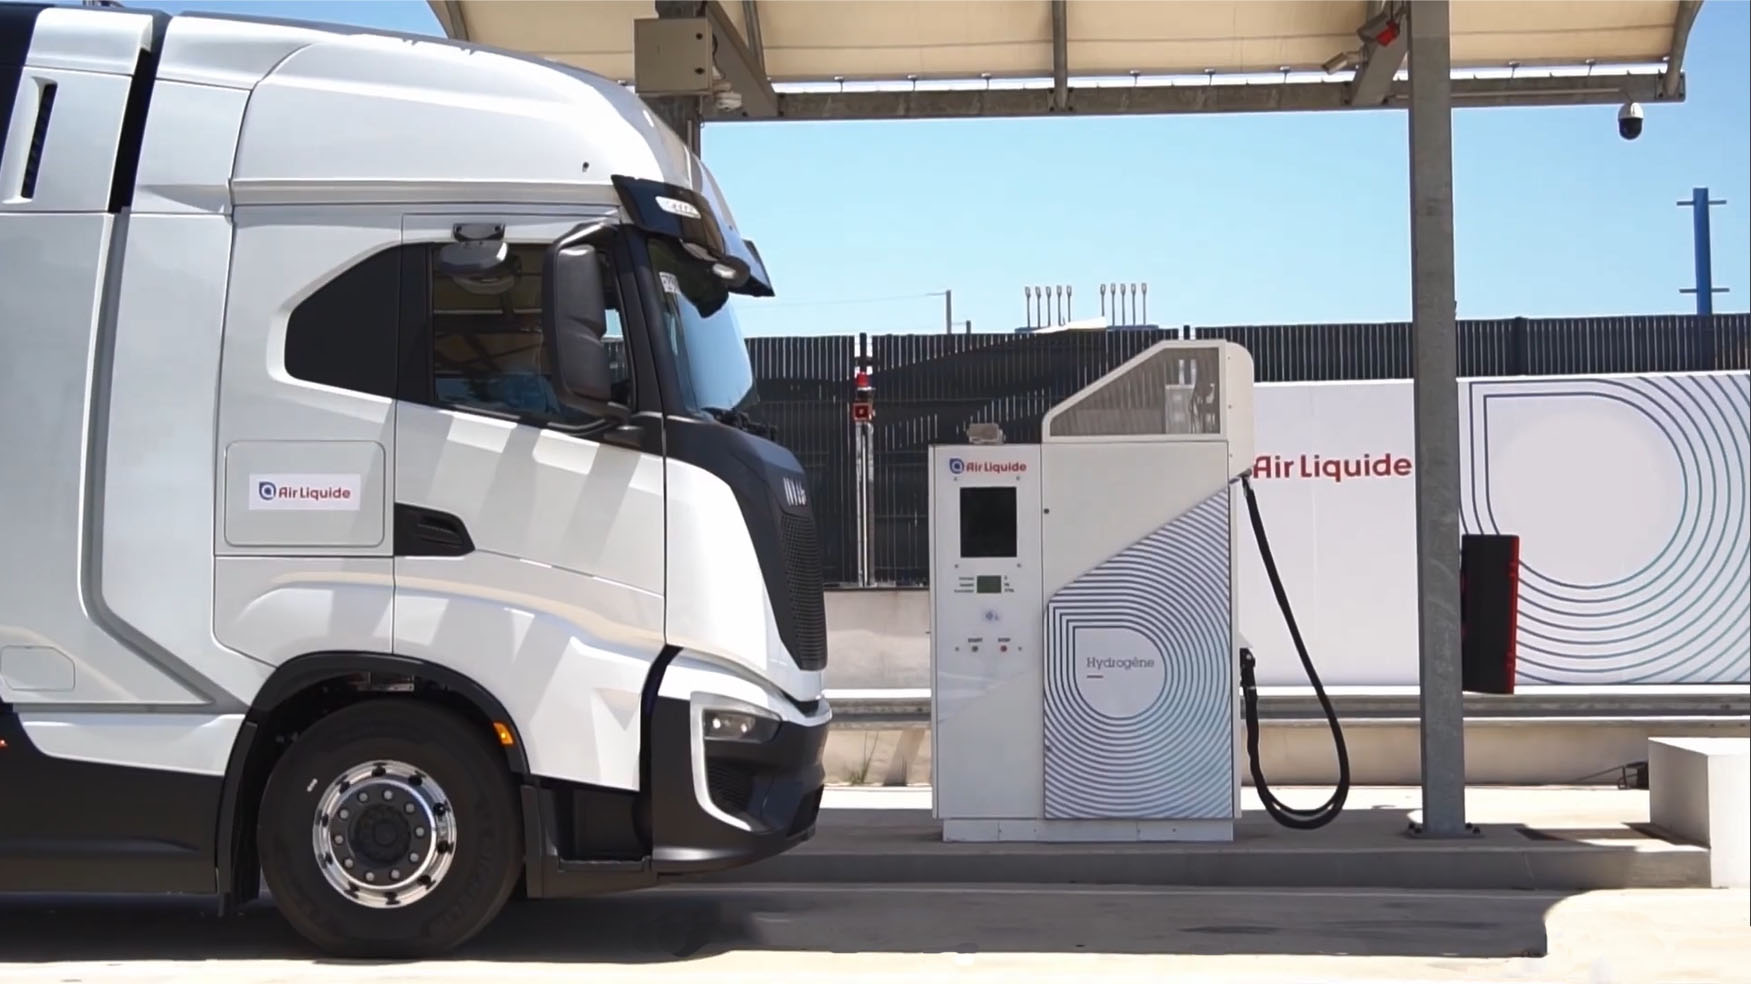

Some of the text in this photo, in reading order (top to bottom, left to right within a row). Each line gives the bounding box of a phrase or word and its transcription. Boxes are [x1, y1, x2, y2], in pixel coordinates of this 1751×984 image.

[966, 461, 1027, 474] Air Liquide
[1253, 453, 1413, 483] Air Liquide
[279, 486, 351, 501] Air Liquide
